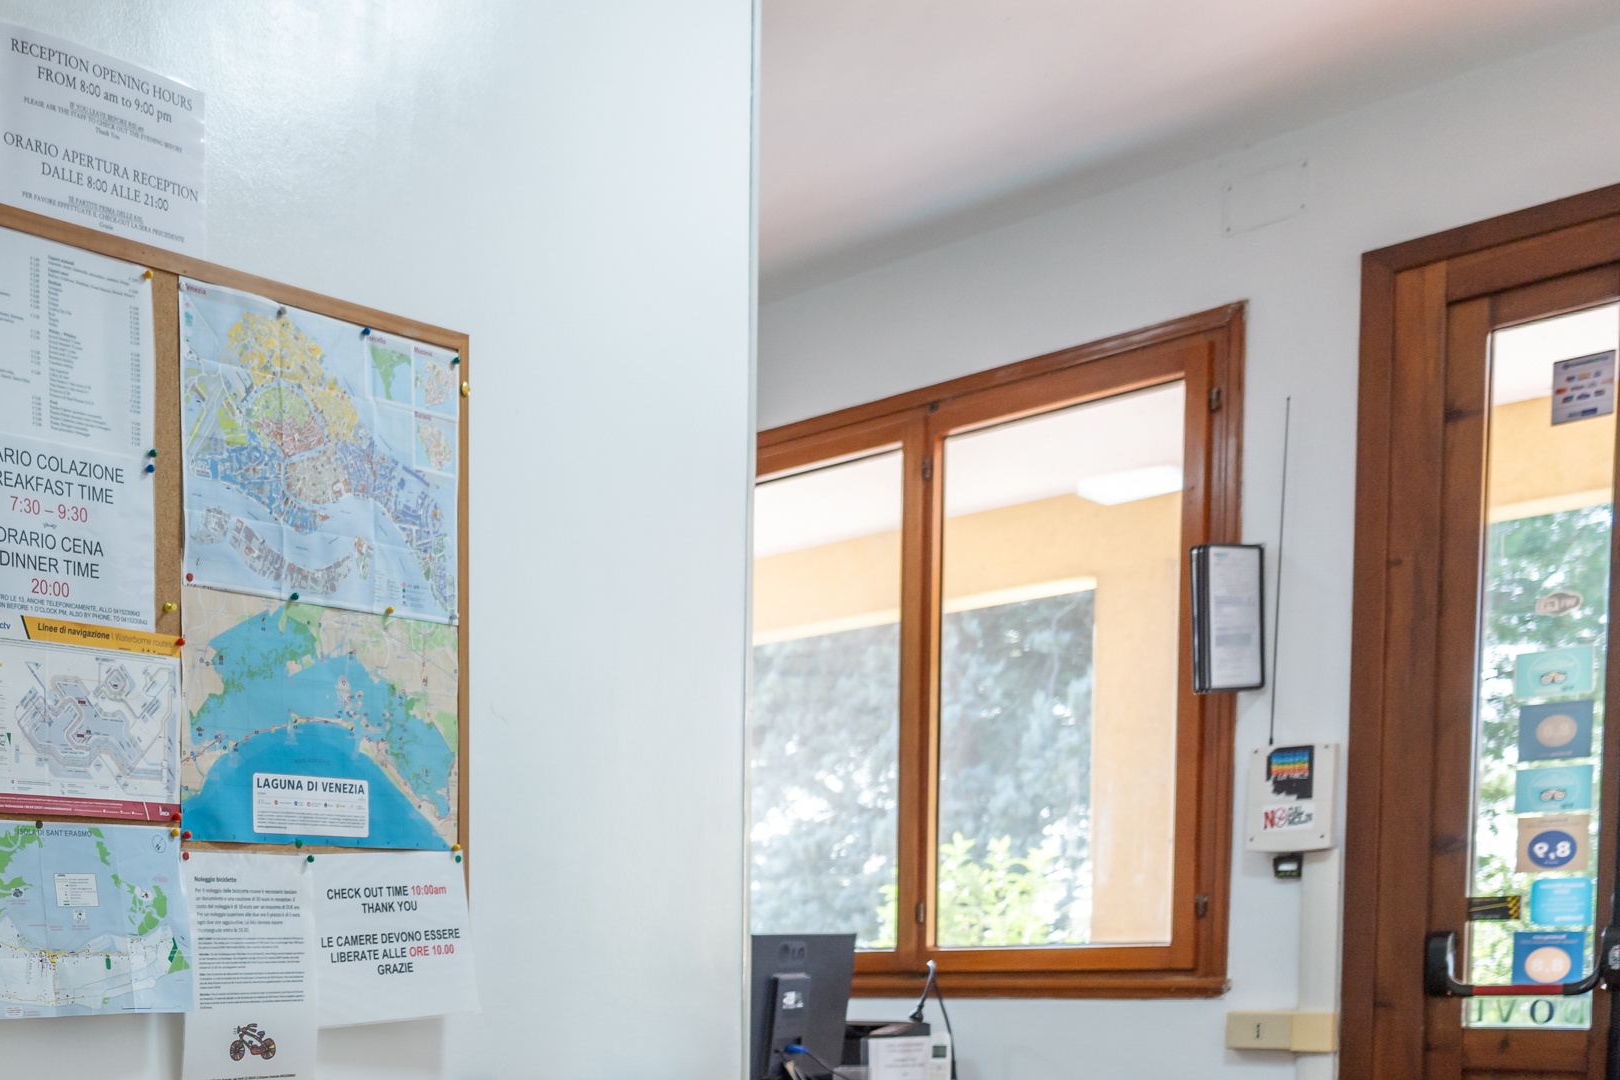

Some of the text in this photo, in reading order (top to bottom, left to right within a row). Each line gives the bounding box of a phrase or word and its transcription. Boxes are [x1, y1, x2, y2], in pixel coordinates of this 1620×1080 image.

[10, 38, 193, 111] RECEPTION OPENING HOURS
[37, 66, 172, 124] FROM 8:00 am to 9:00 pm
[3, 132, 198, 202] ORARIO APERTURA RECEPTION
[41, 162, 168, 211] DALLE 8:00 ALLE 21:00
[36, 454, 124, 484] COLAZIONE
[78, 483, 114, 504] TIME
[10, 496, 88, 523] 7:30 9:30
[61, 536, 104, 557] CENA
[0, 550, 100, 579] DINNER TIME
[31, 578, 69, 598] 20:00
[37, 623, 110, 640] Linee di navigazione
[115, 632, 173, 648] Waterborne routes
[256, 778, 365, 795] LAGUNA DI VENEZIA
[18, 828, 36, 836] ISOLA
[46, 829, 92, 838] SANT'ERASMO
[194, 876, 215, 884] Noleggio
[326, 884, 446, 900] CHECK OUT TIME 10:00am
[362, 901, 418, 915] THANK YOU
[321, 928, 460, 948] LE CAMERE DEVONO ESSERE
[330, 944, 454, 964] LIBERATE ALLE ORE 10.00
[377, 962, 414, 975] GRAZIE
